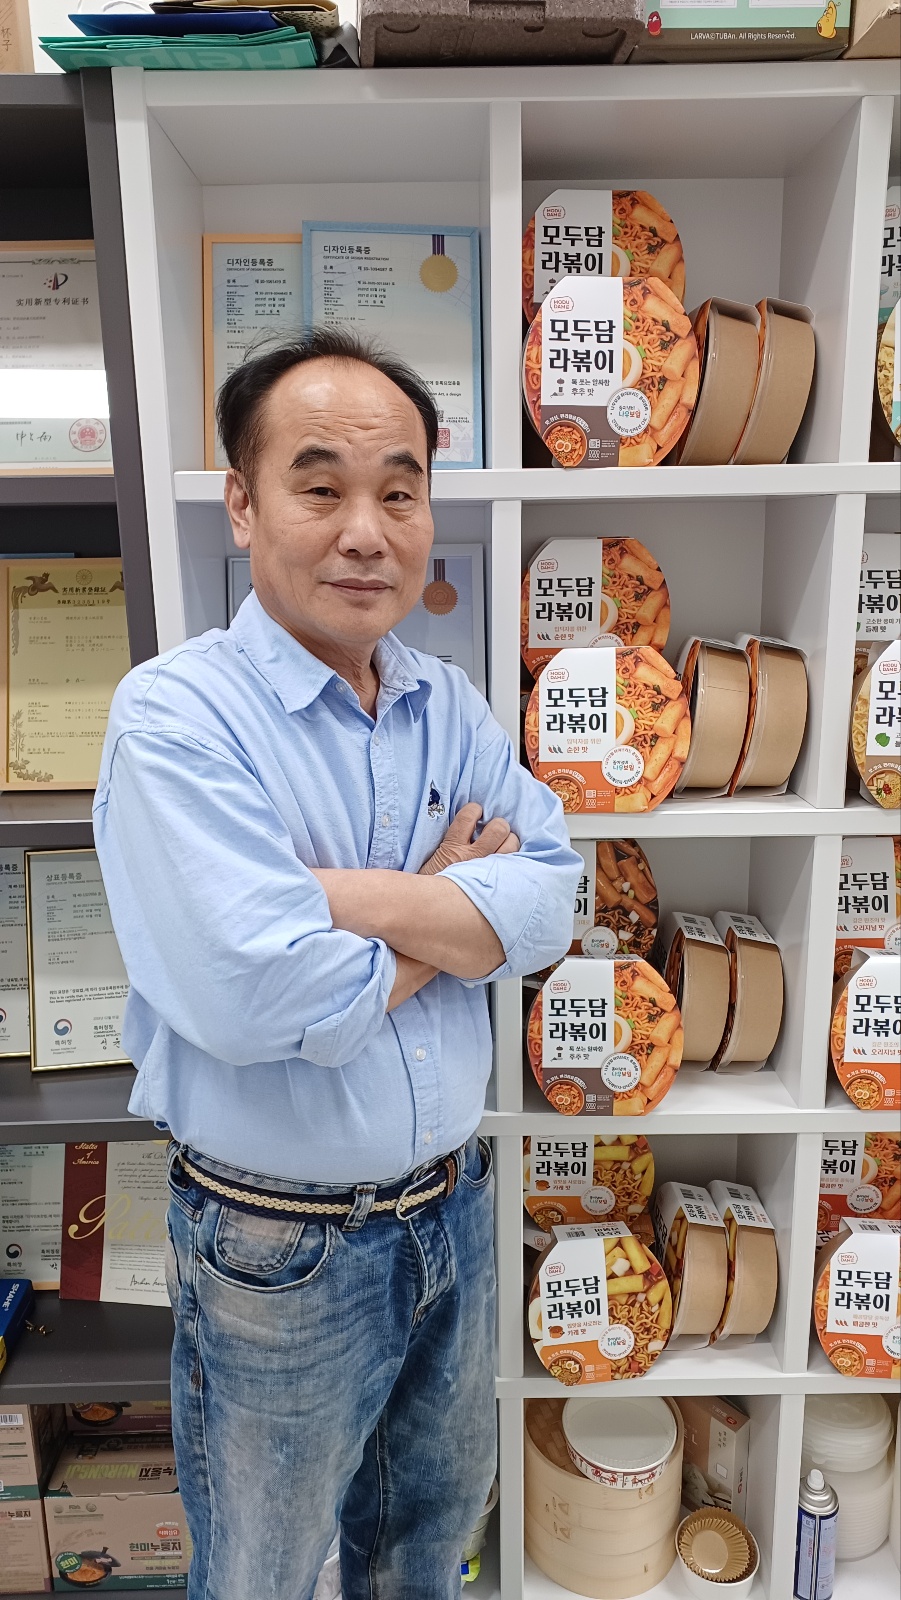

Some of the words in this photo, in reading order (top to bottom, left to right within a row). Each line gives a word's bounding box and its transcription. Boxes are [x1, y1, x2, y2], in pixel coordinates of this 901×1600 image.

[1, 26, 12, 52] 杯子
[738, 32, 748, 40] All
[748, 32, 766, 41] Rights
[768, 32, 796, 40] Reserved.
[541, 226, 605, 247] 모두담
[323, 245, 370, 254] 디자인등록증
[227, 258, 274, 266] 디자인등록증
[541, 251, 603, 274] 라볶이
[16, 297, 89, 306] 实用新型专利证书
[549, 319, 616, 343] 모두담
[549, 348, 614, 373] 라볶이
[535, 577, 595, 597] 모두담
[860, 570, 901, 589] 두담
[536, 602, 592, 621] 라볶이
[546, 687, 608, 708] 모두담
[546, 712, 607, 733] 라볶이
[46, 873, 82, 882] 상표등록증
[548, 998, 608, 1017] 모두담
[549, 1022, 606, 1041] 라볶이
[535, 1142, 588, 1158] 모두담
[822, 1140, 858, 1156] 두담
[535, 1161, 586, 1176] 라볶이
[821, 1159, 856, 1175] 볶이
[546, 1276, 600, 1299] 모두담
[835, 1269, 892, 1290] 모두담
[2, 1283, 20, 1308] SHAHE
[835, 1292, 890, 1312] 라볶이
[547, 1298, 601, 1320] 라볶이
[129, 1542, 181, 1551] 현미누룽지
[60, 1556, 78, 1569] 현미
